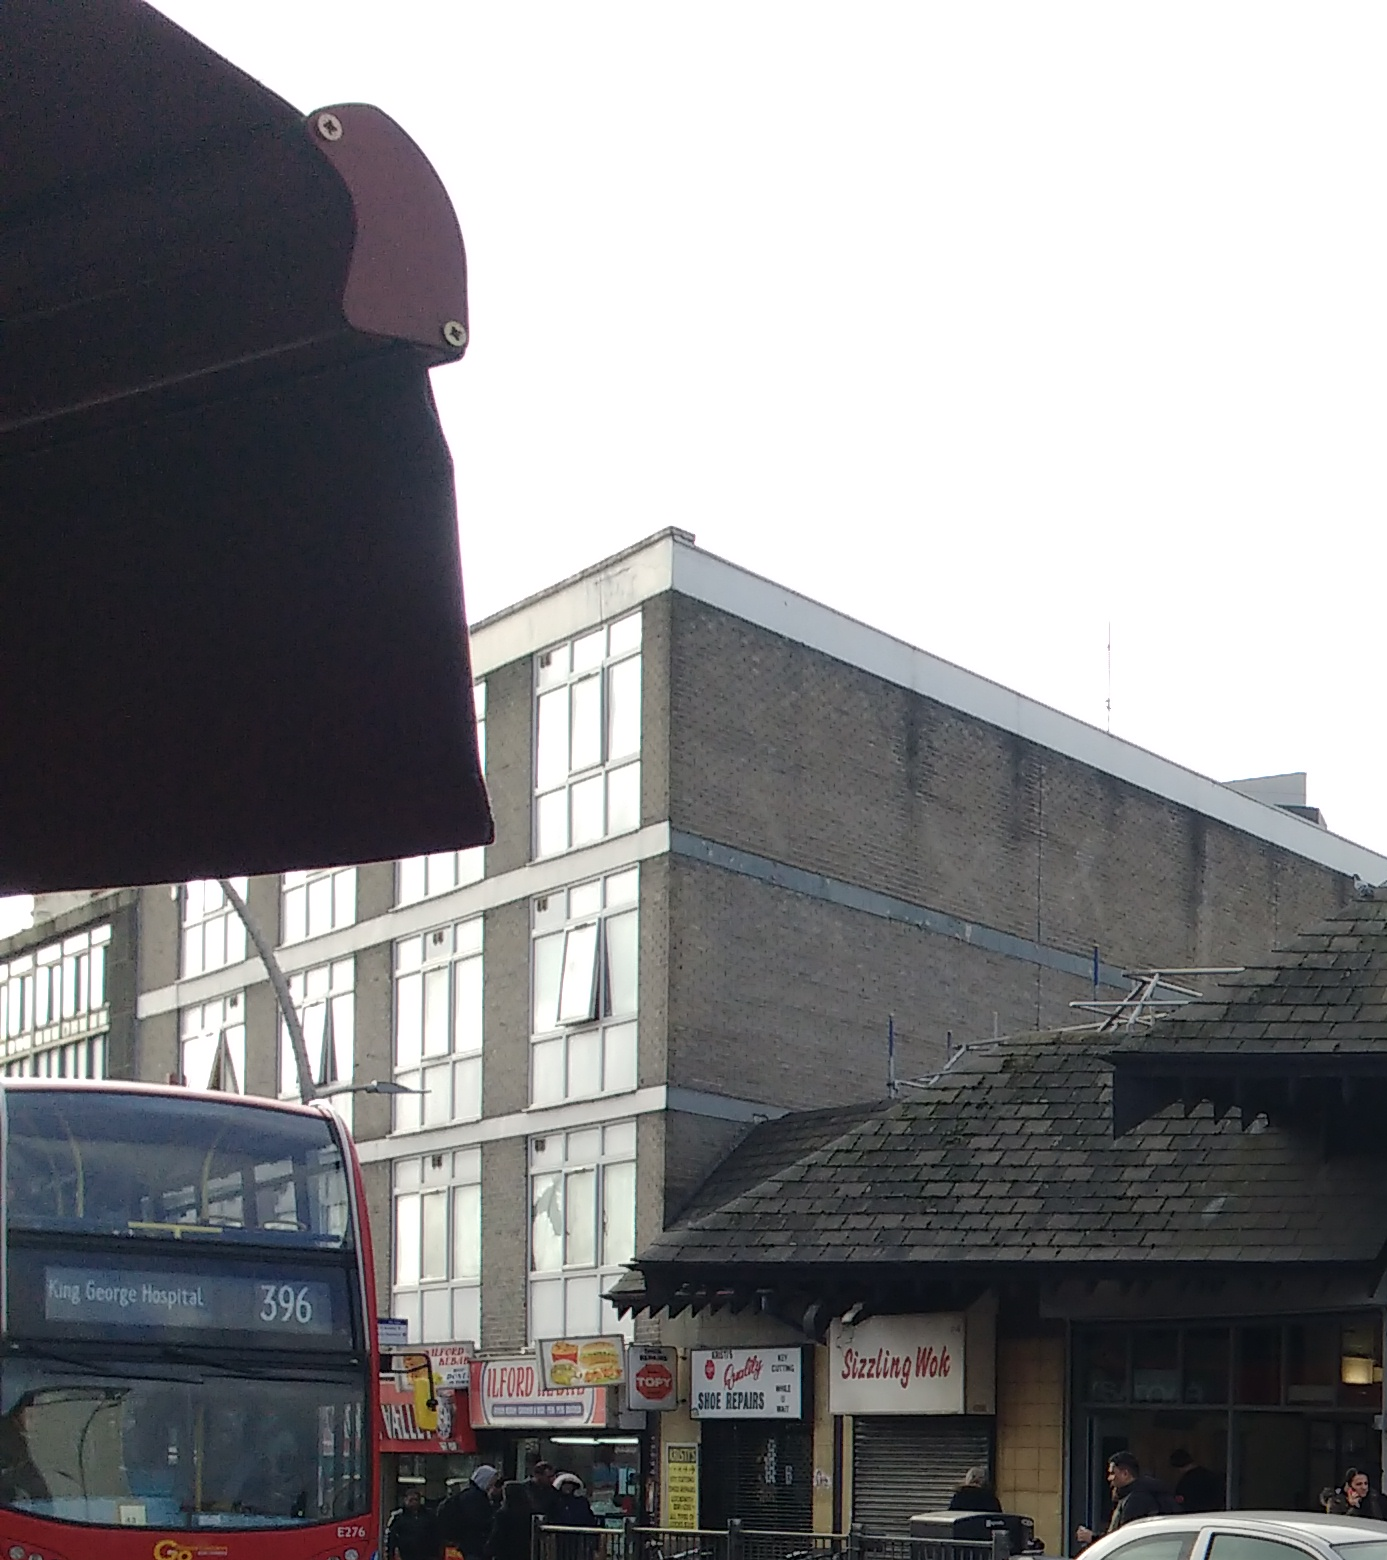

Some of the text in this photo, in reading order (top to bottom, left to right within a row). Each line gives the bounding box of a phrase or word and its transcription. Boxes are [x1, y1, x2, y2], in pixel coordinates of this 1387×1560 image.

[49, 1279, 204, 1310] King George Hospital
[259, 1284, 314, 1324] 396
[431, 1346, 464, 1358] ILFORD
[777, 1353, 788, 1362] KEY
[723, 1354, 765, 1390] Quality
[841, 1345, 951, 1389] Sizzling Wok
[486, 1366, 535, 1398] ILFORD
[636, 1376, 672, 1388] TOPY
[698, 1391, 765, 1410] SHOE REPAIRS
[337, 1526, 366, 1539] E276
